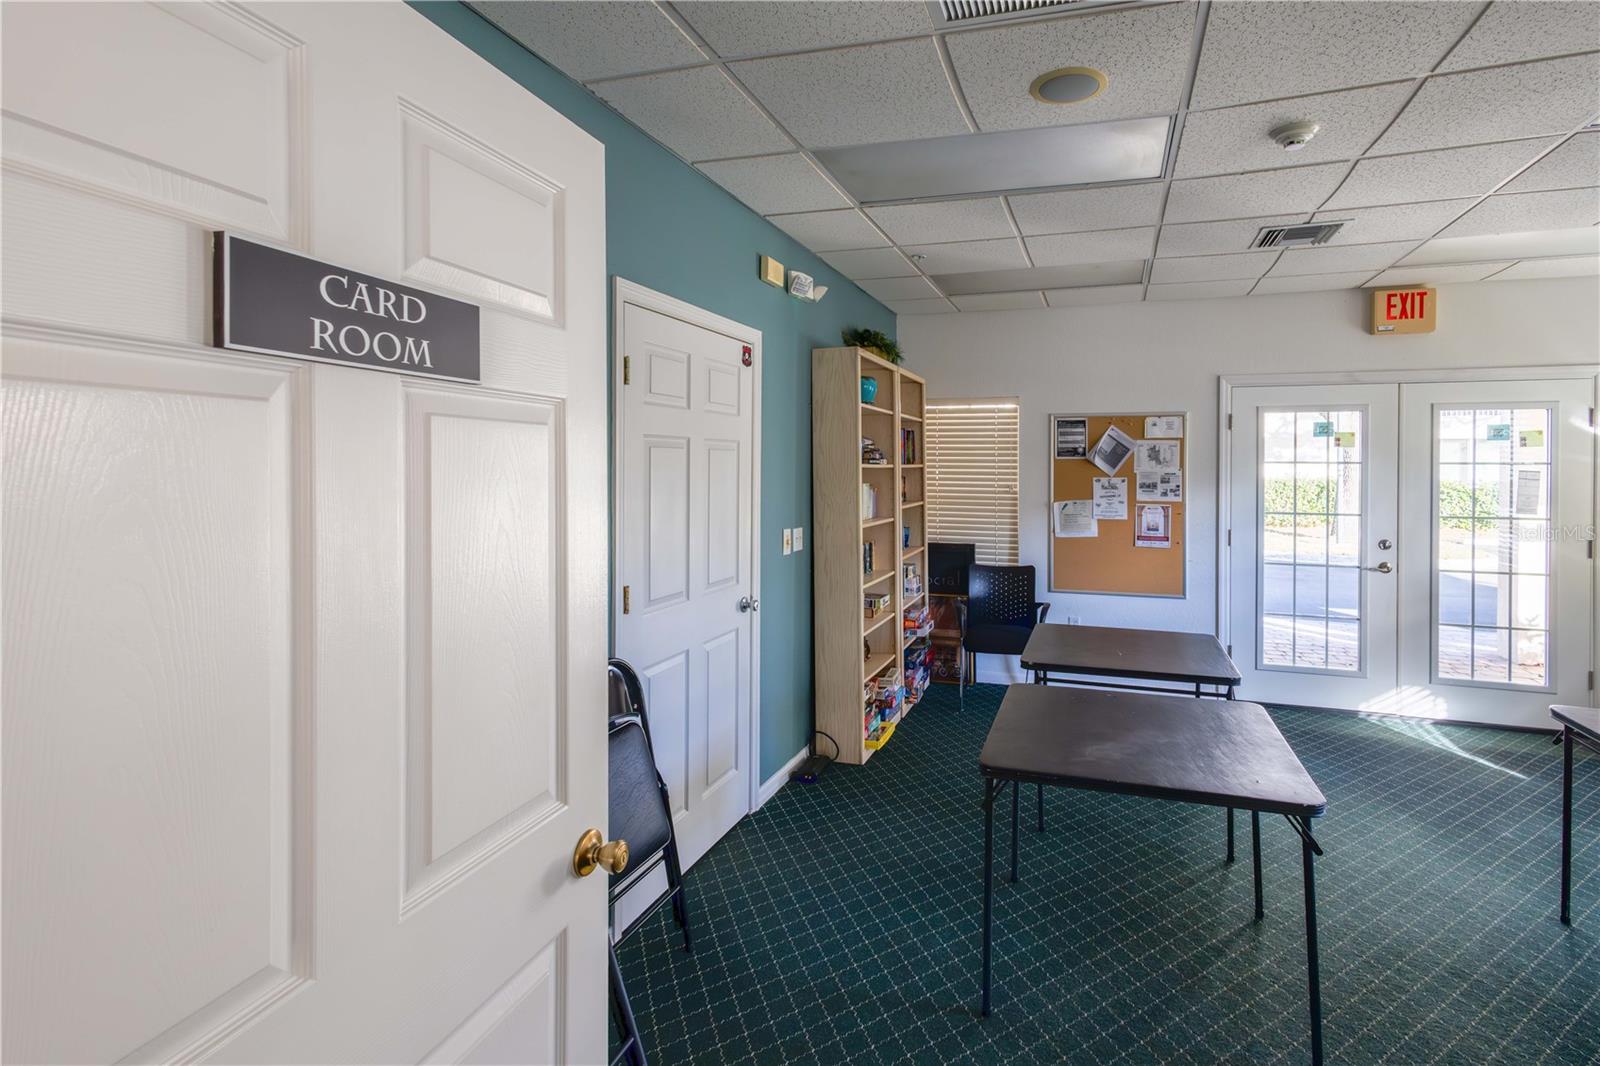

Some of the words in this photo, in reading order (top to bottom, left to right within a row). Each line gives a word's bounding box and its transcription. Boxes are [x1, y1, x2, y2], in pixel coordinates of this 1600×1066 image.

[319, 274, 427, 323] CARD
[1386, 291, 1428, 320] EXIT
[309, 316, 434, 368] ROOM
